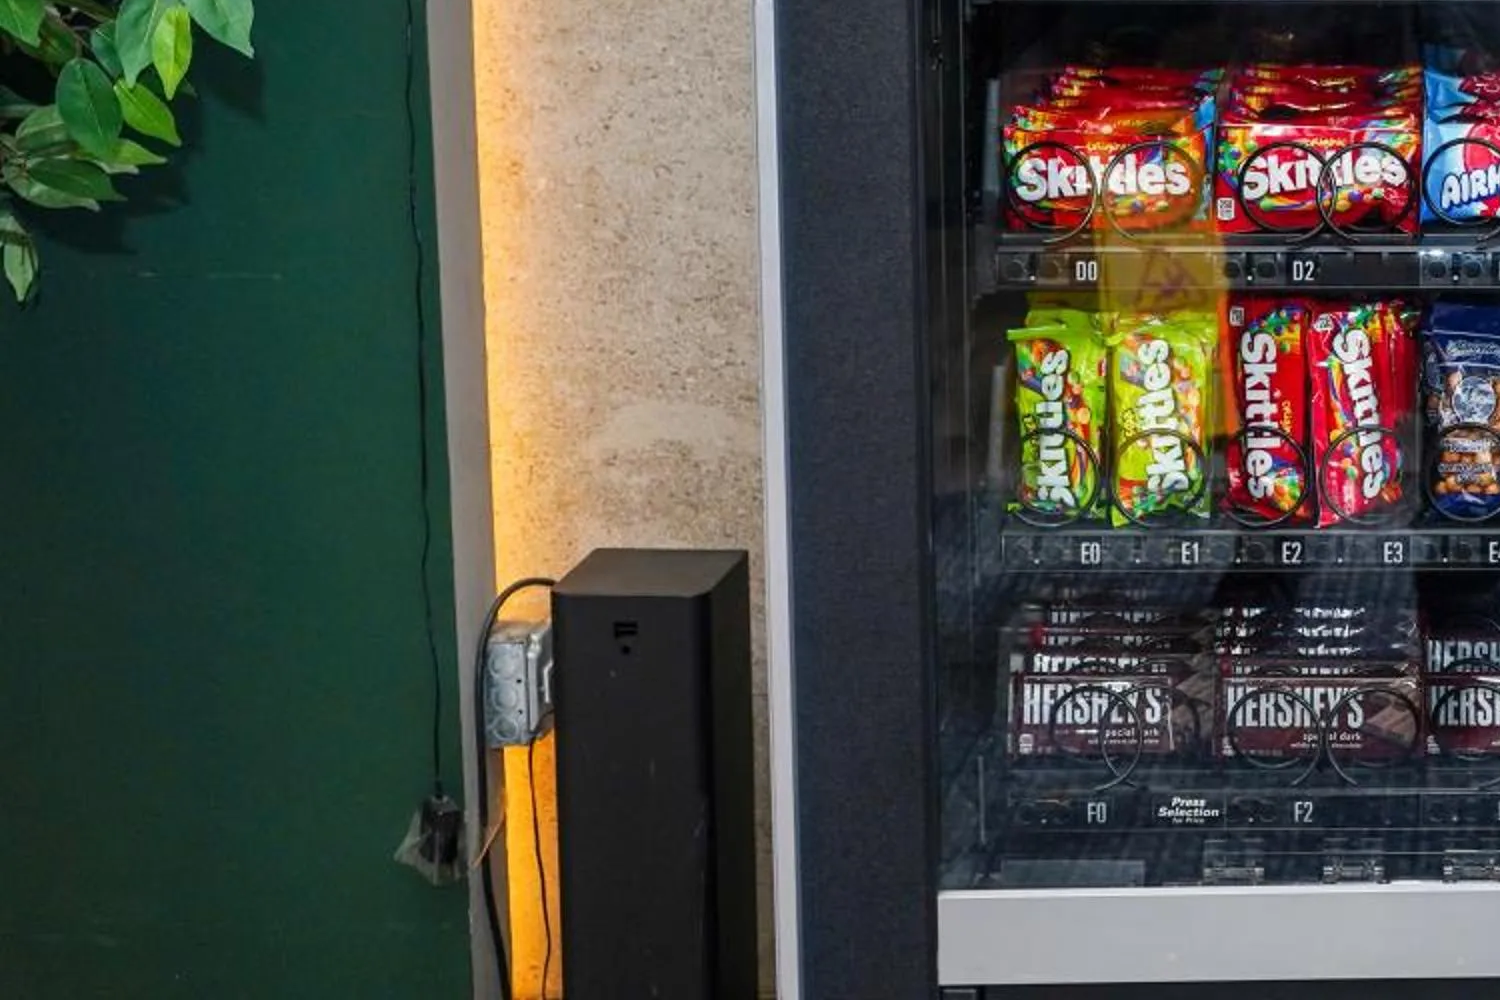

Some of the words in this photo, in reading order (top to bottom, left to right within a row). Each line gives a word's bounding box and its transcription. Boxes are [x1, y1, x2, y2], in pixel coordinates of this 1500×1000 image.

[1016, 152, 1191, 202] Skittles
[1241, 150, 1408, 202] Skittles
[1075, 260, 1098, 281] D0
[1293, 260, 1315, 281] D2
[1241, 331, 1281, 499] Skittles
[1080, 542, 1101, 564] E0
[1181, 541, 1199, 565] E1
[1282, 541, 1302, 564] E2
[1383, 541, 1403, 564] E3
[1143, 728, 1160, 737] ark
[1087, 801, 1107, 823] F0
[1158, 806, 1219, 817] Selection
[1171, 796, 1206, 807] Press
[1294, 801, 1313, 823] F2
